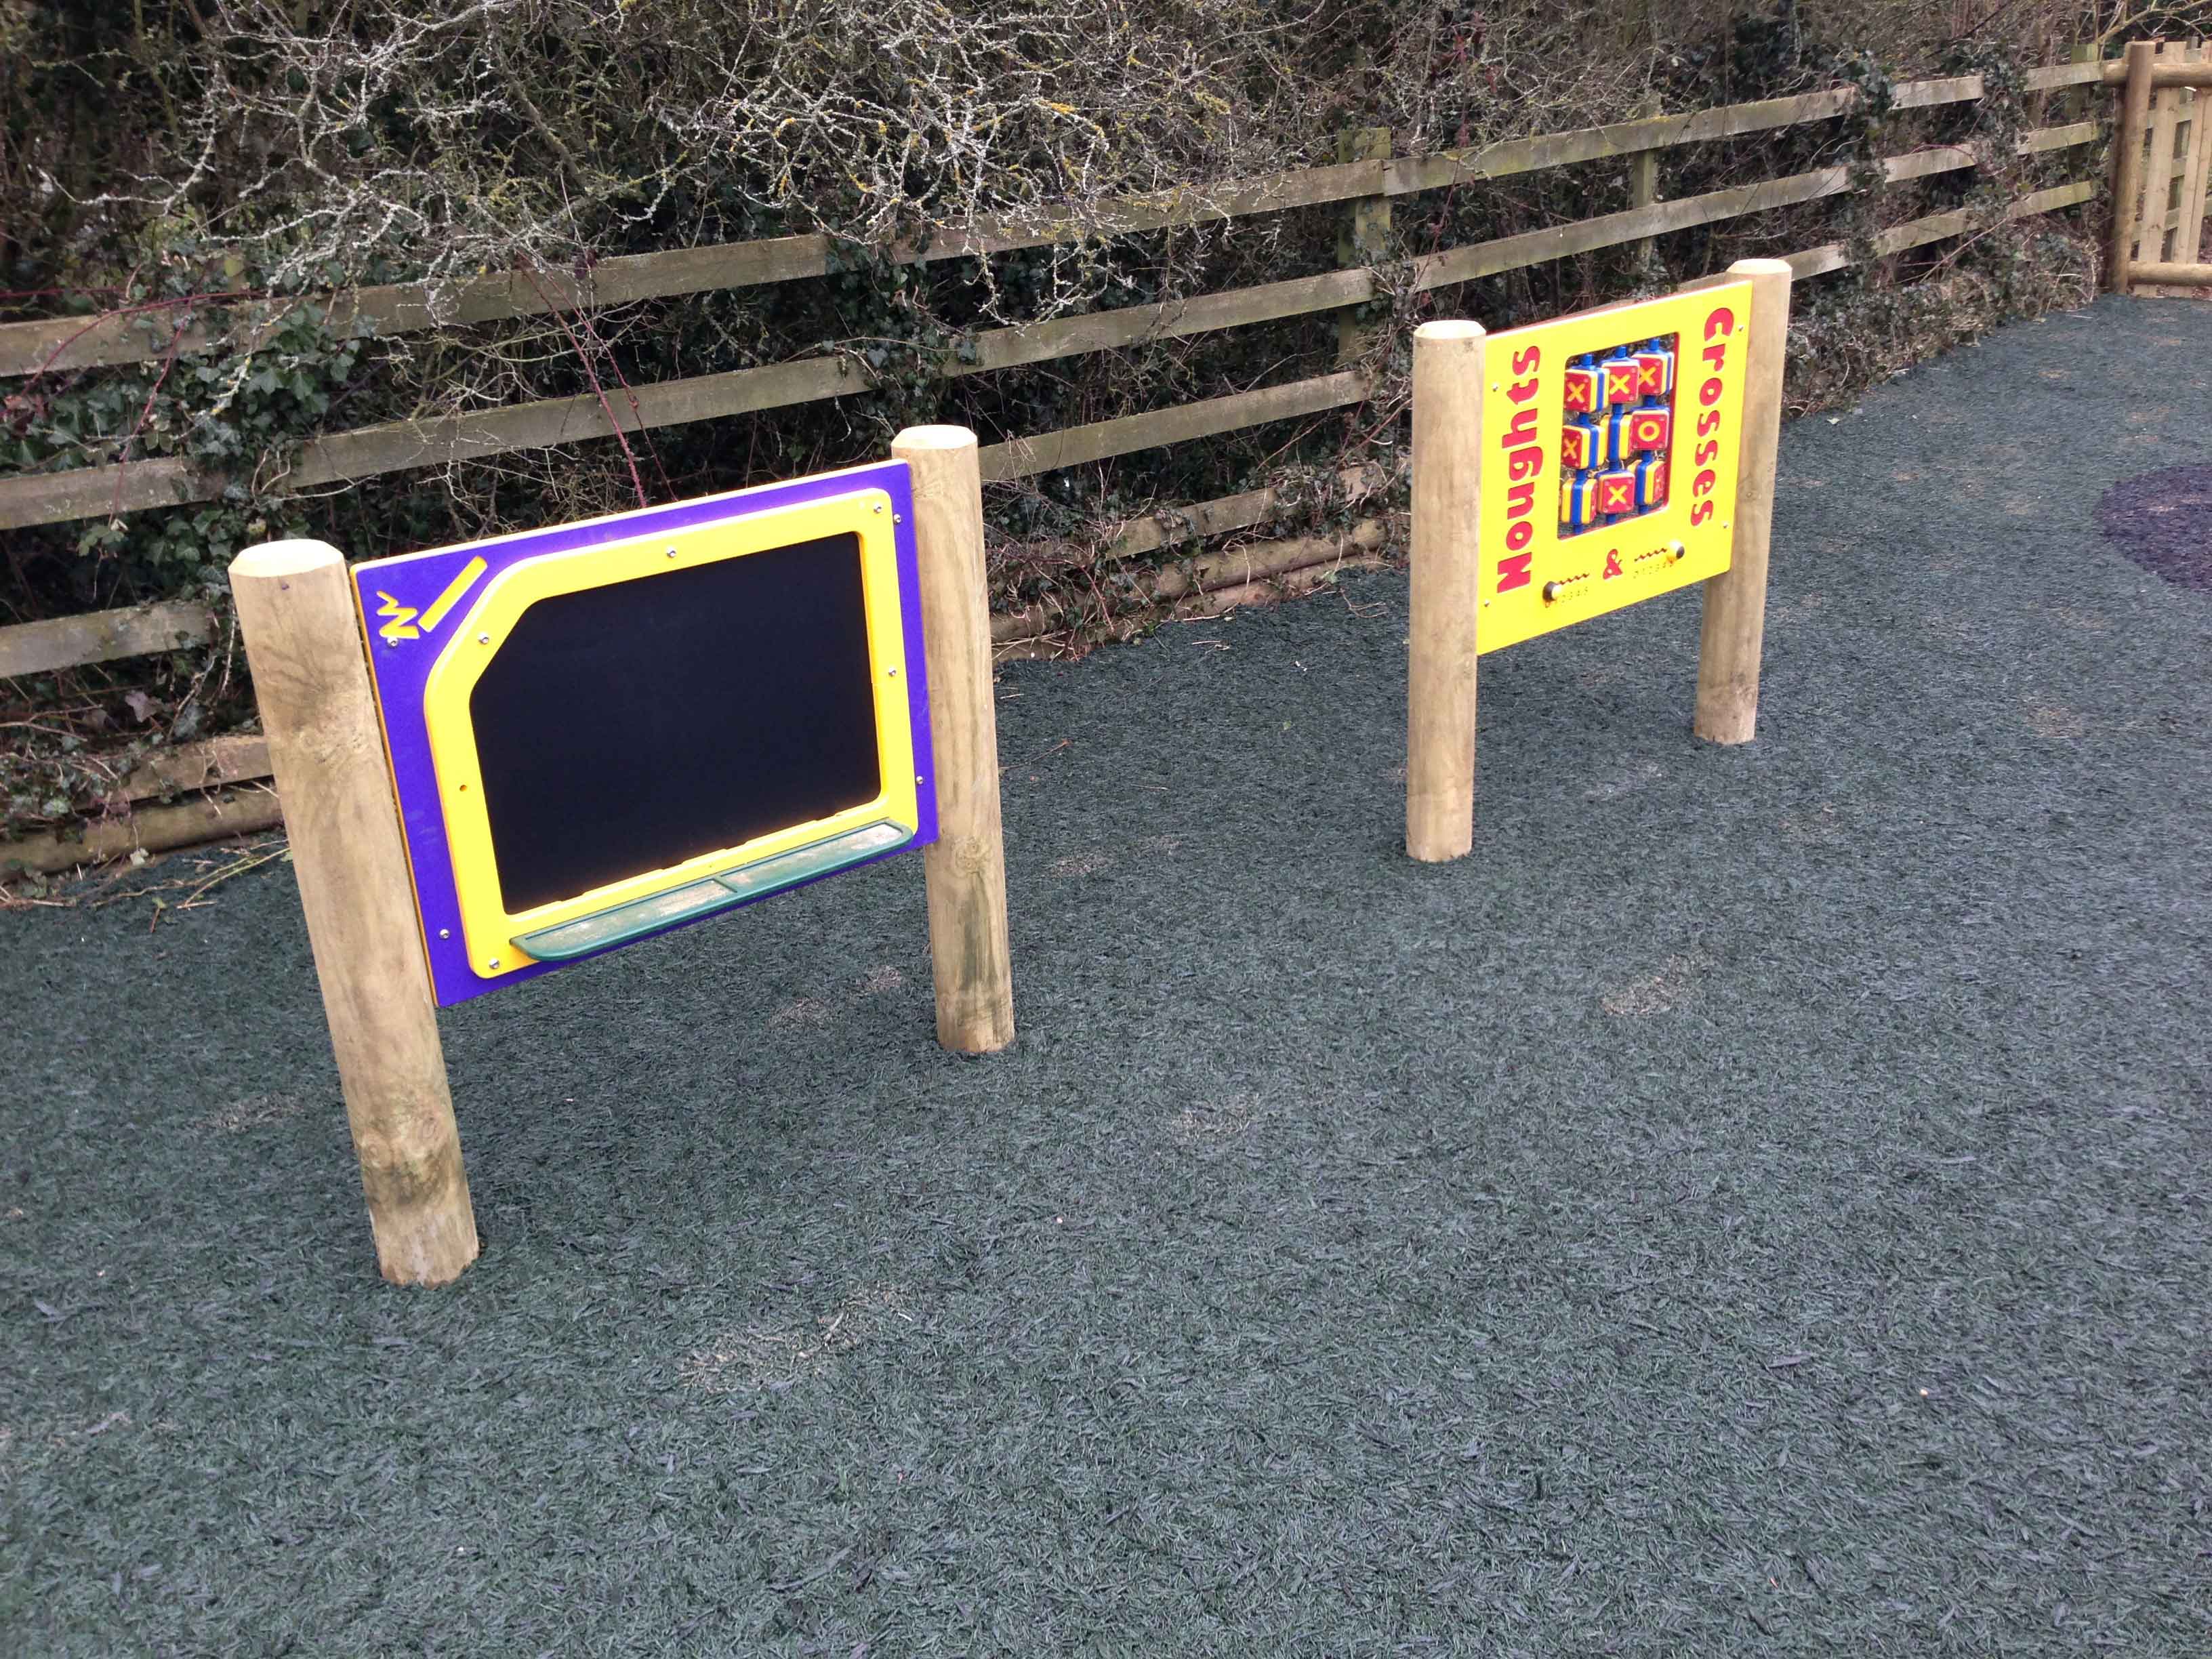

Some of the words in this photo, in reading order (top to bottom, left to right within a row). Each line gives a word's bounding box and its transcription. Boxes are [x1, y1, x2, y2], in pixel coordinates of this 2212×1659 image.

[1496, 345, 1544, 594] Noughts
[1691, 307, 1735, 527] Crosses
[1602, 548, 1623, 580] &
